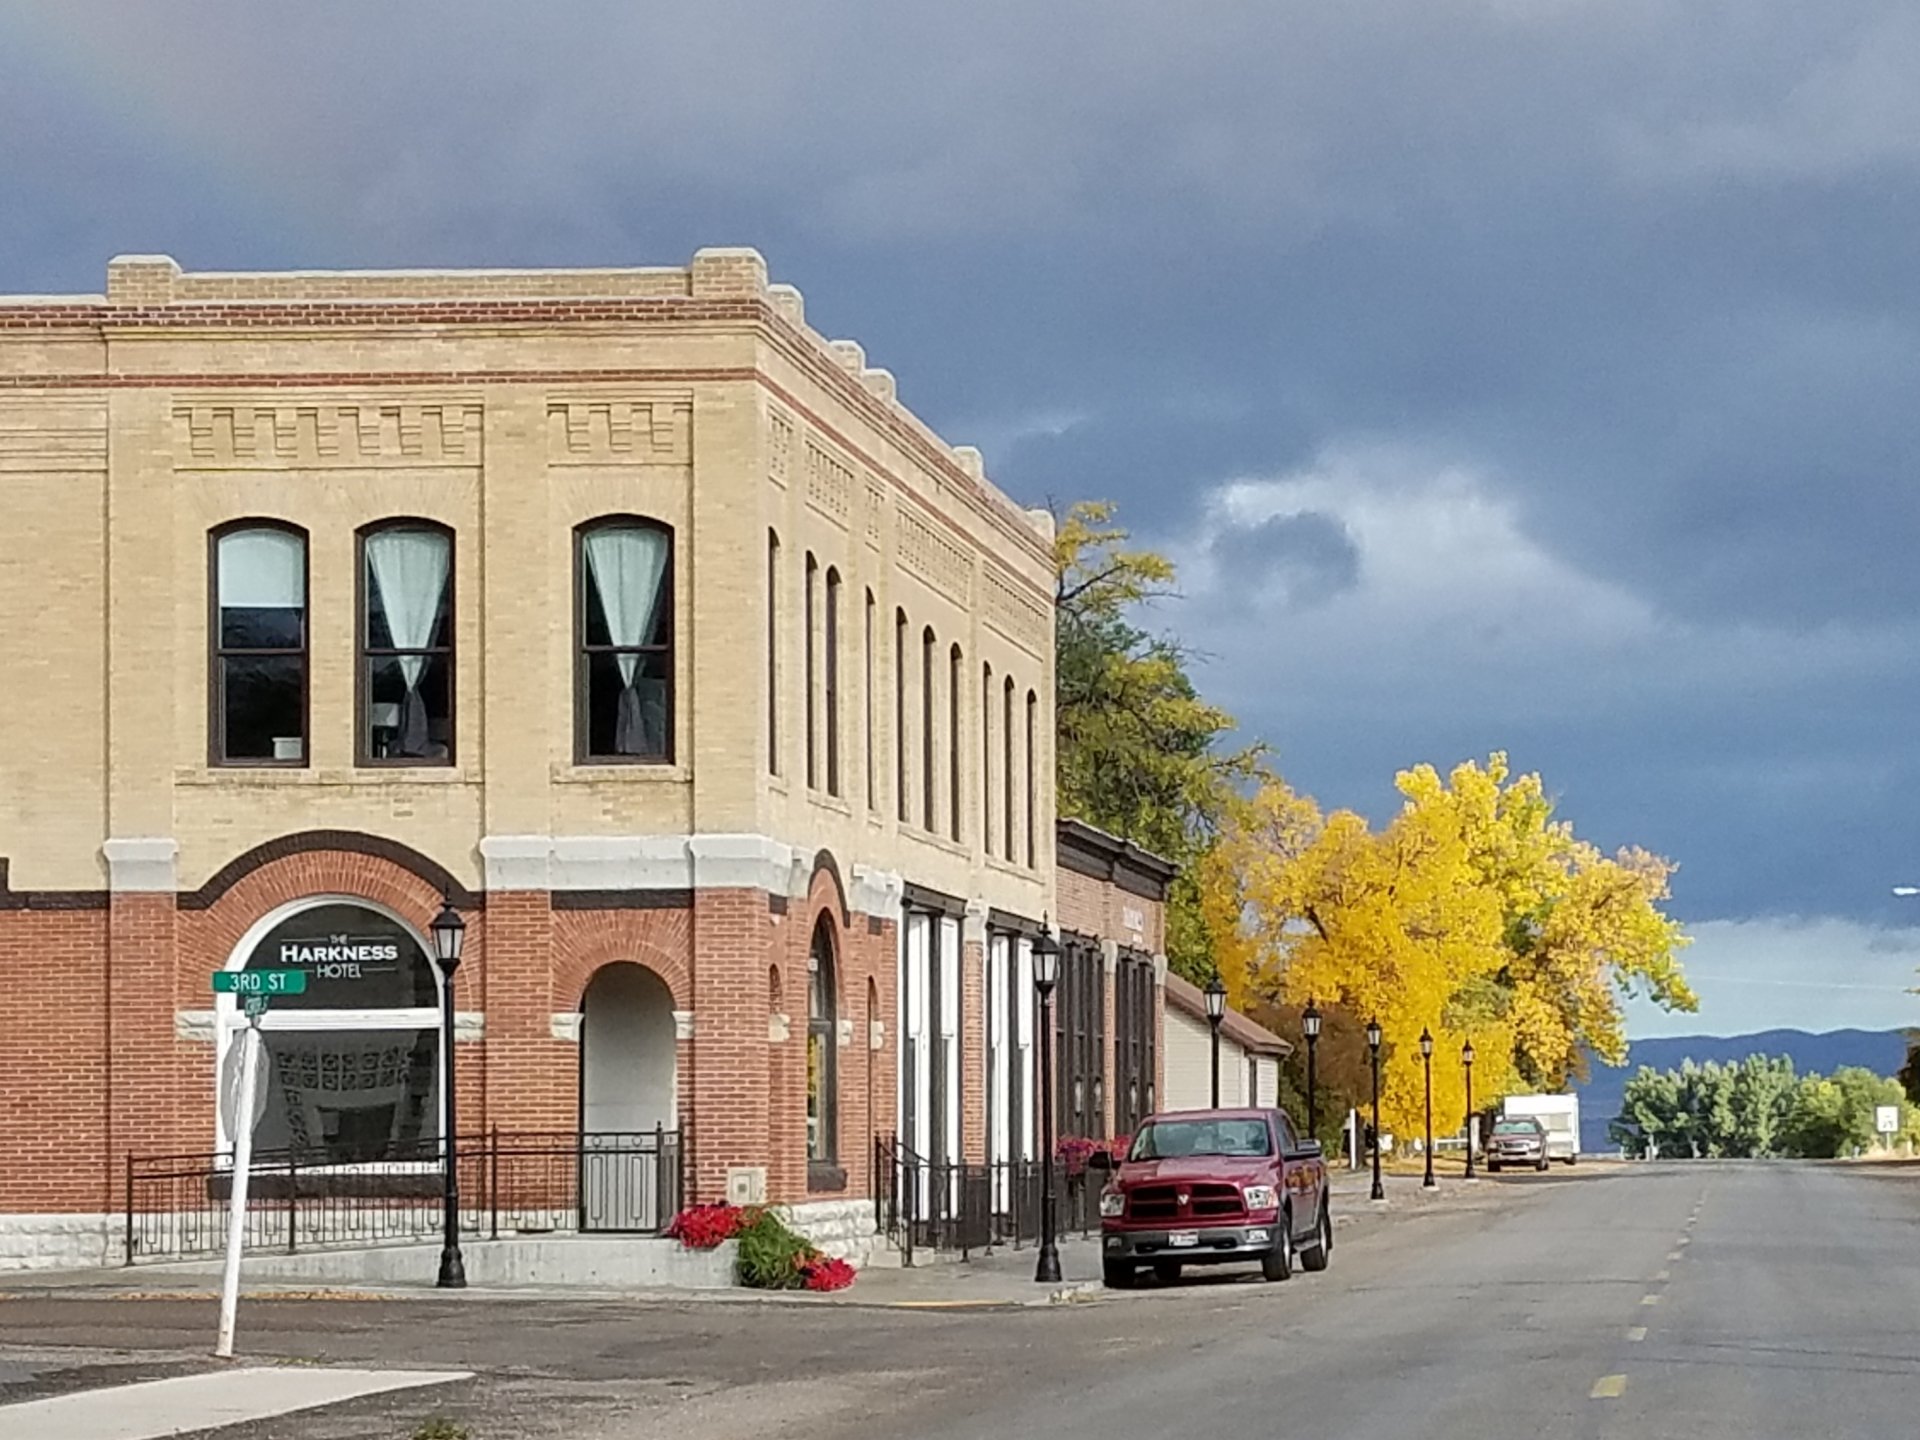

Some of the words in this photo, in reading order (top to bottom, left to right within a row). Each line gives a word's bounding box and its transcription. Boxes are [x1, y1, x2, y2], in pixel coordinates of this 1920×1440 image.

[329, 934, 347, 945] THE
[281, 945, 398, 962] HARKNESS
[317, 963, 361, 978] HOTEL
[230, 973, 261, 991] 3RD
[268, 973, 286, 990] ST
